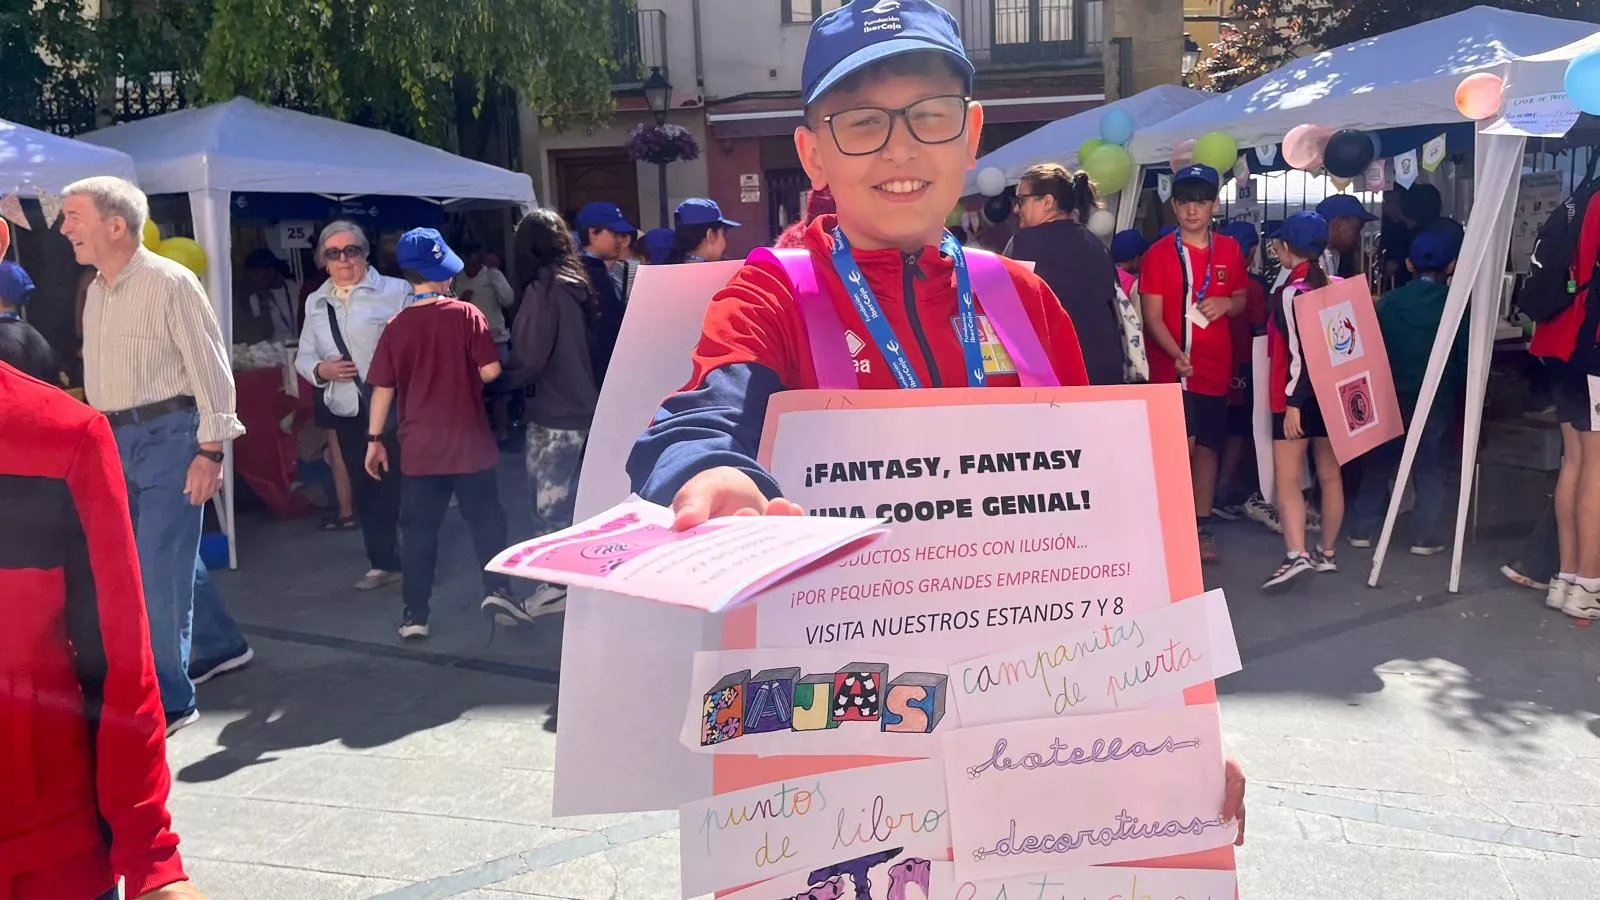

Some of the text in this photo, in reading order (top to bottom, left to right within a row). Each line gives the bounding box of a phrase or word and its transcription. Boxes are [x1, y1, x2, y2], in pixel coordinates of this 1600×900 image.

[864, 16, 899, 26] Fundación
[1239, 187, 1250, 199] 03
[287, 227, 305, 240] 25
[853, 293, 871, 322] Fundación
[892, 361, 909, 388] undación
[805, 449, 1081, 487] ¡FANTASY, FANTASY
[876, 499, 973, 524] COOPE
[982, 490, 1091, 516] GENIAL!
[915, 543, 978, 561] HECHOS
[982, 540, 1015, 556] CON
[1019, 533, 1088, 553] ILUSIÓN...
[791, 562, 1131, 608] ¡POR PEQUEÑOS GRANDES EMPRENDEDORES!
[805, 596, 1124, 645] VISITA NUESTROS ESTANDS 7 Y 8
[963, 620, 1145, 696] campanitas
[1054, 638, 1202, 715] de puerta
[701, 661, 947, 746] CAJAS
[977, 736, 1199, 772] botellas
[698, 782, 827, 857] puntos
[753, 796, 946, 867] de libro
[987, 809, 1220, 856] decorativas
